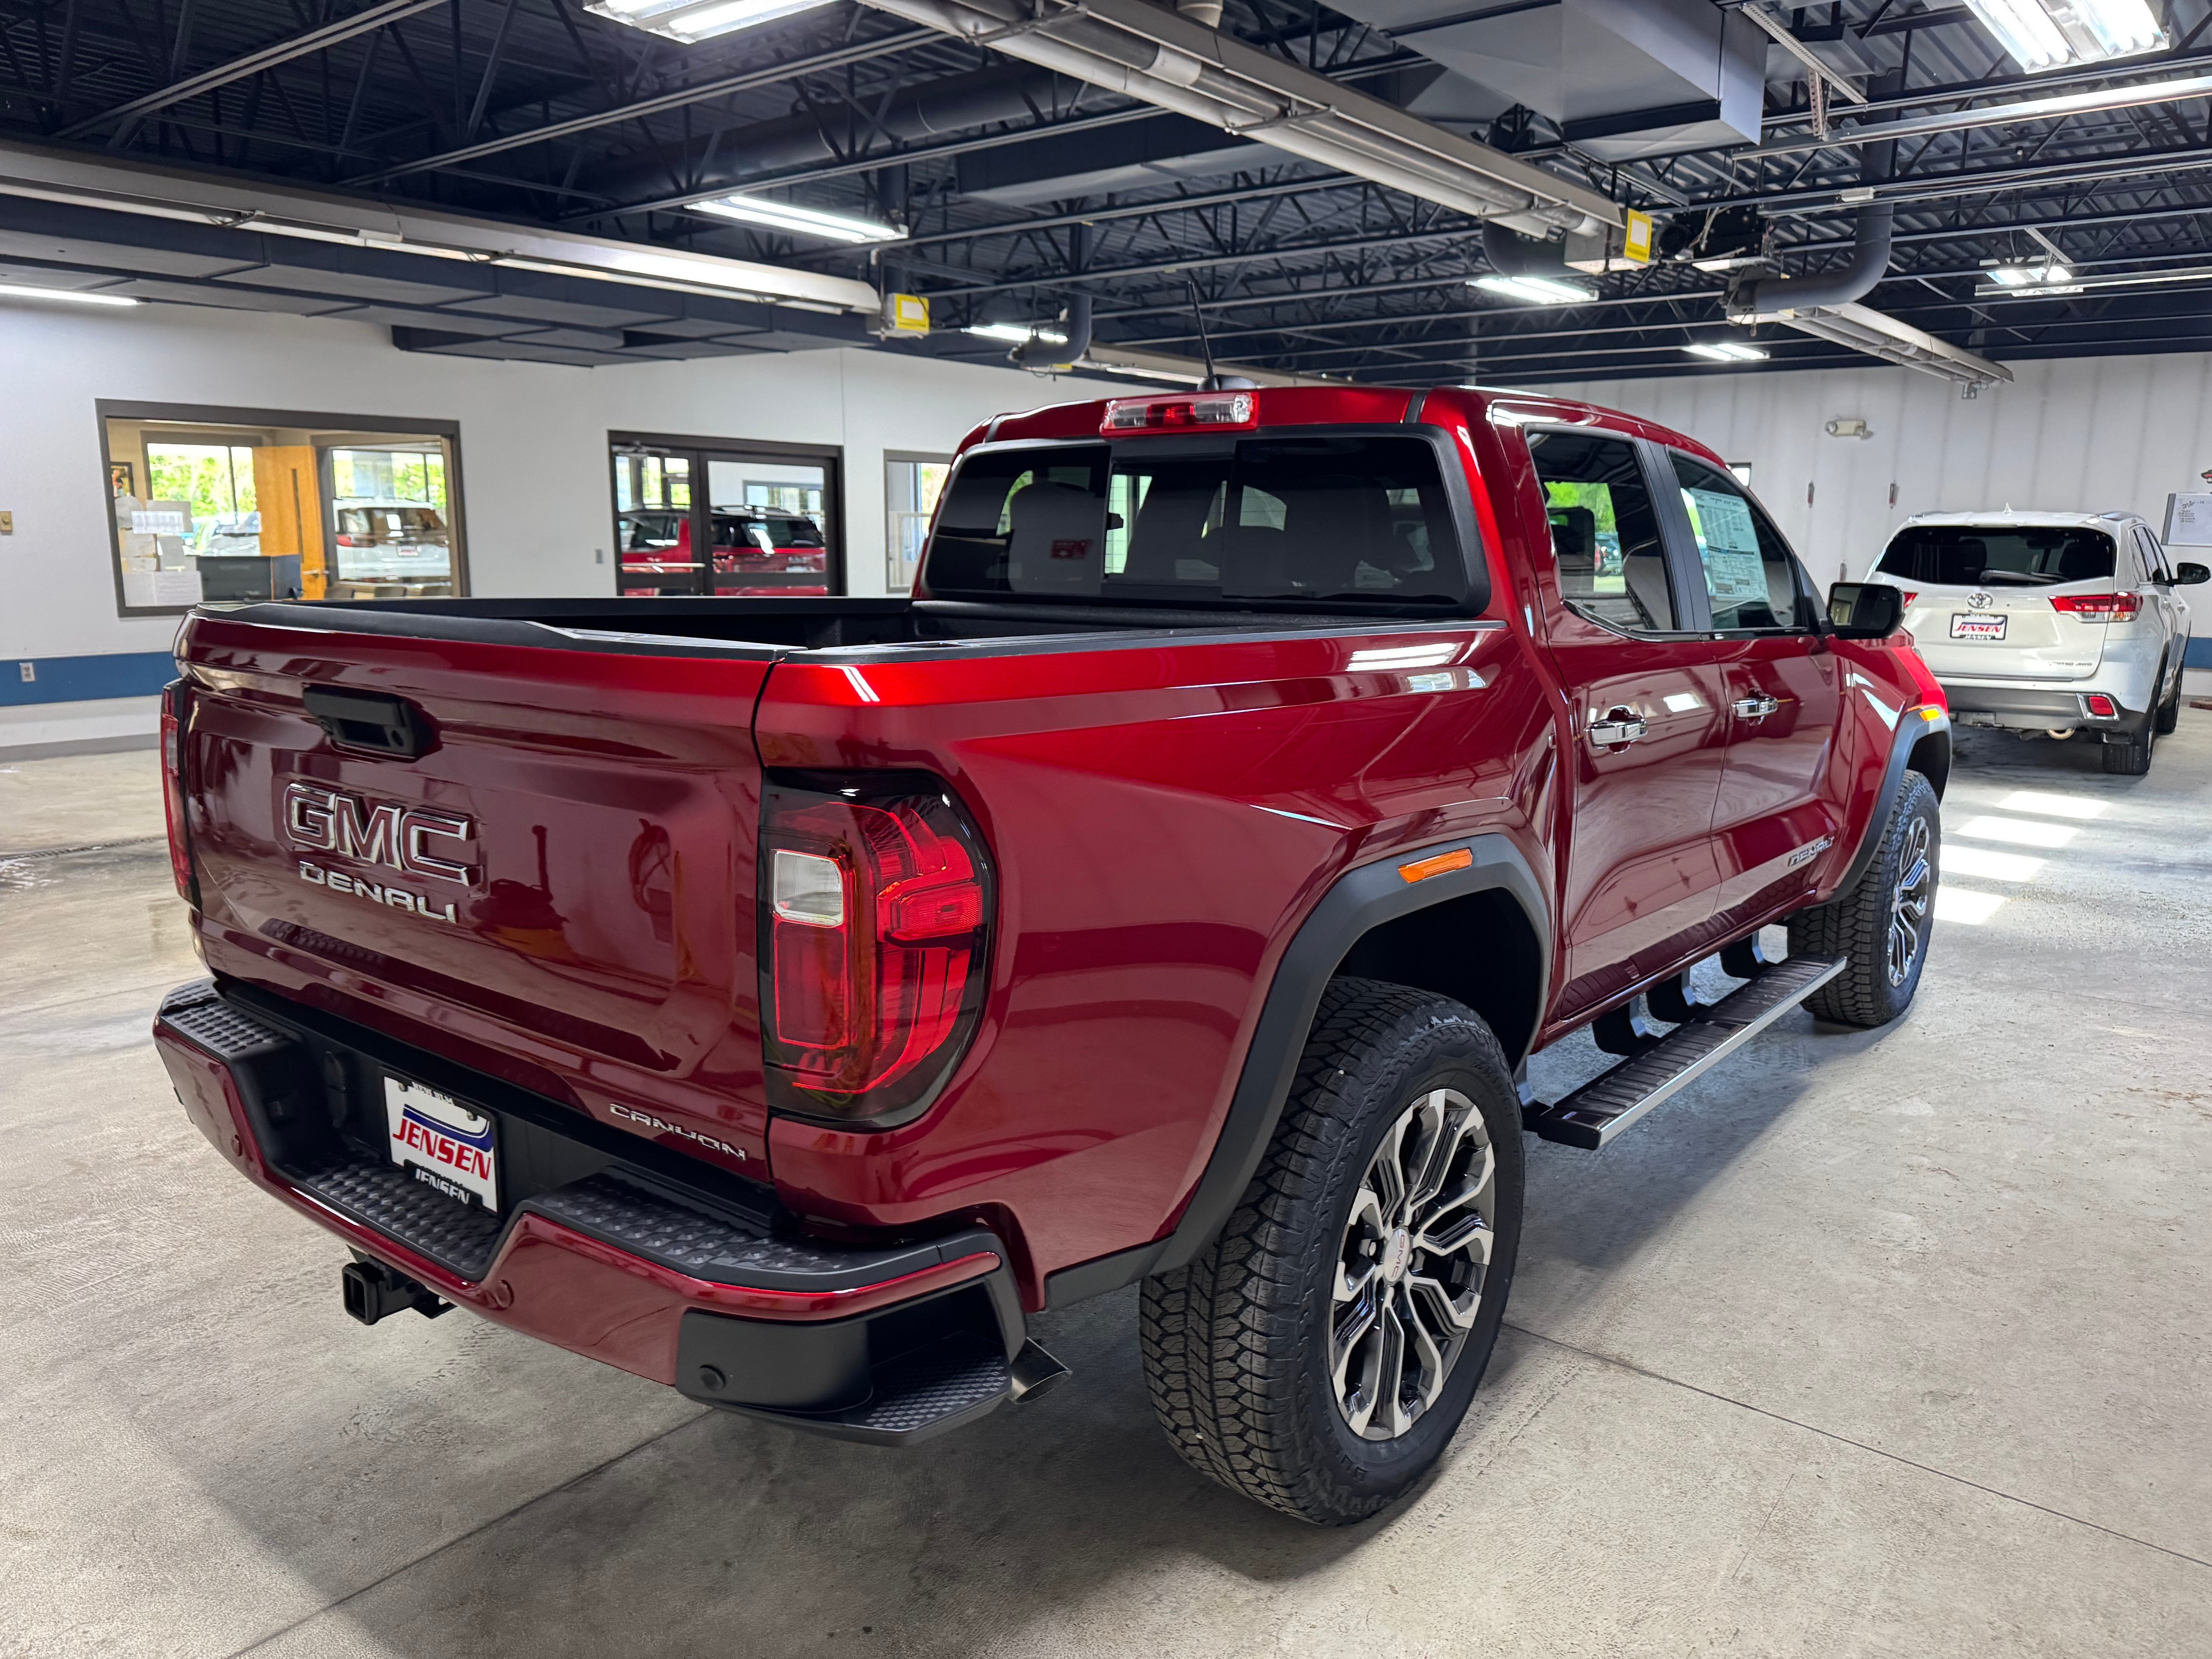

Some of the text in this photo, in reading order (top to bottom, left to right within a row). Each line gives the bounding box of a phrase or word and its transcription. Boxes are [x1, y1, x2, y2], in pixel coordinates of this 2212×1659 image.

[1954, 623, 2001, 632] JENSEN
[284, 781, 483, 887] GMC
[299, 860, 458, 924] DENALI
[392, 1118, 491, 1181] JENSEN
[610, 1103, 747, 1161] CANYON
